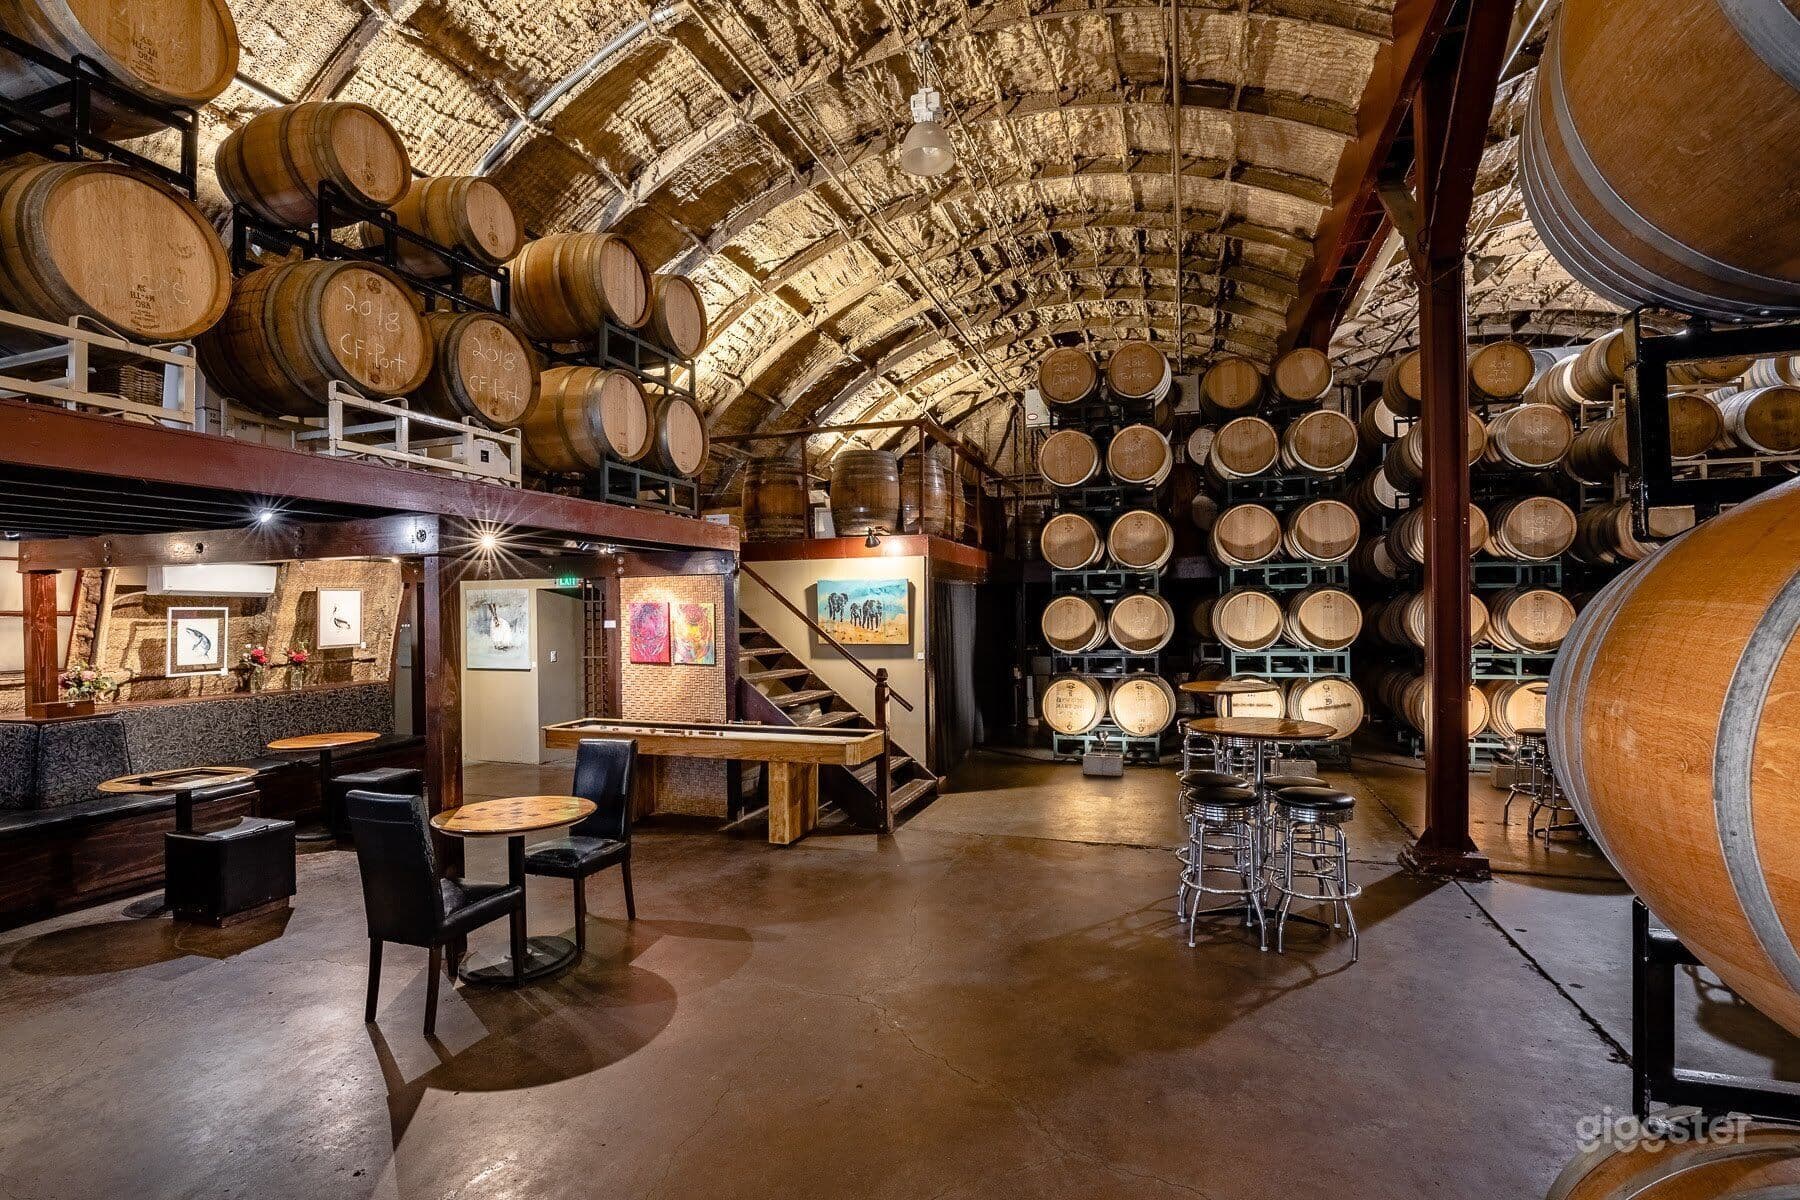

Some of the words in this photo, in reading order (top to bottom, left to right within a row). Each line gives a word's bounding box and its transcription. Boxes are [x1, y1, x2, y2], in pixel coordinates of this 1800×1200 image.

[342, 285, 400, 332] 2018
[340, 333, 407, 373] CF-Port
[472, 337, 516, 371] 2018
